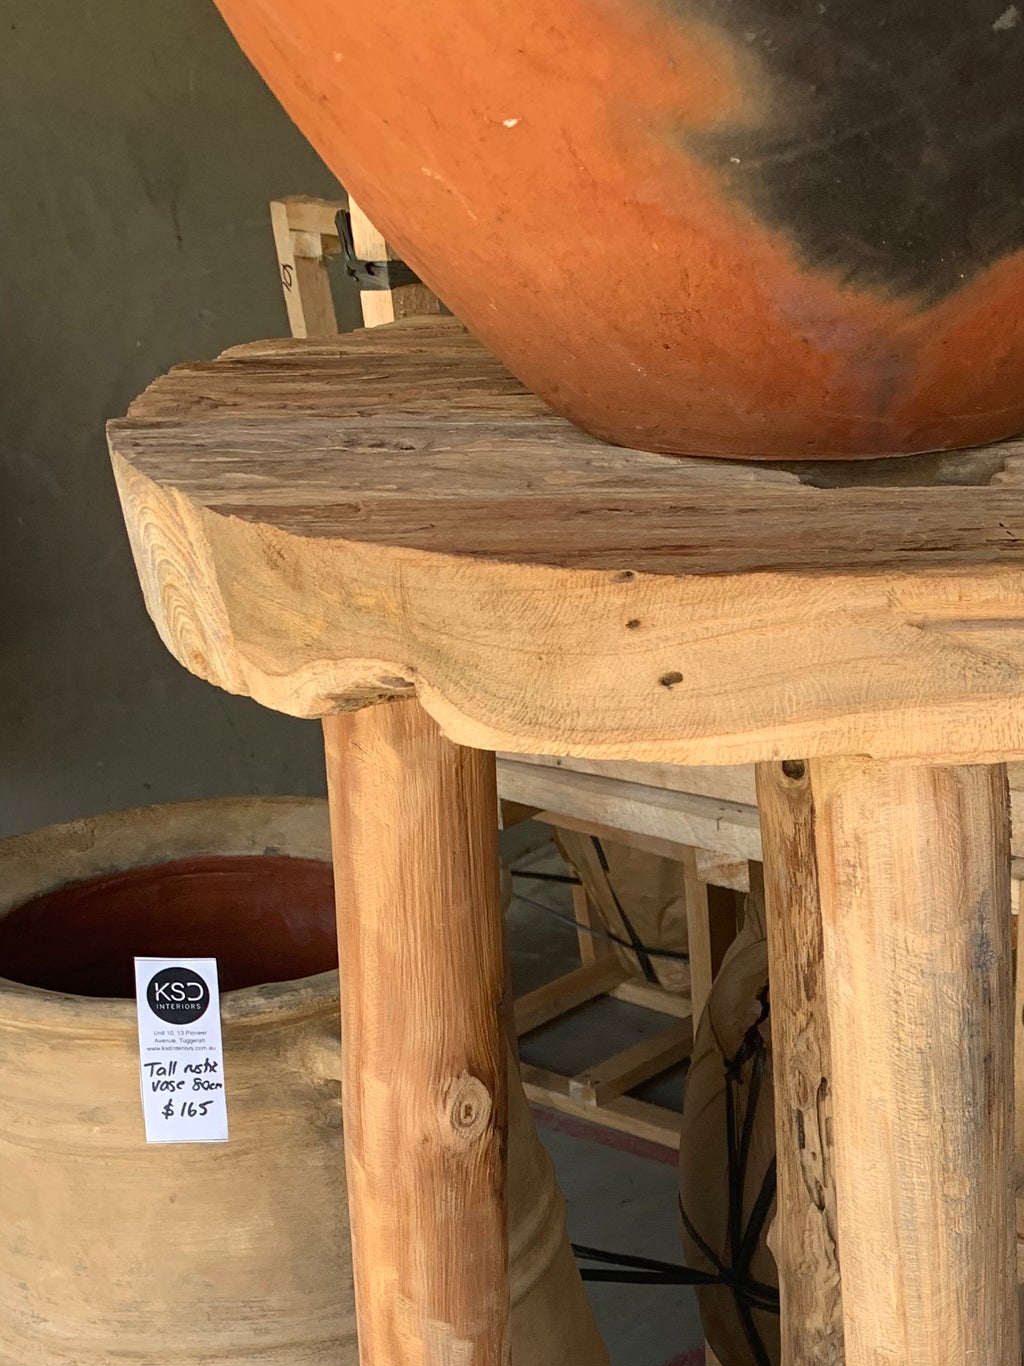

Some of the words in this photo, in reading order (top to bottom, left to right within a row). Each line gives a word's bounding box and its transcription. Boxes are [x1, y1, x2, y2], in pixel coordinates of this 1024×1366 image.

[154, 982, 204, 1002] KSD
[144, 1061, 178, 1077] Tall
[152, 1080, 185, 1092] vase
[192, 1077, 223, 1091] 80cm
